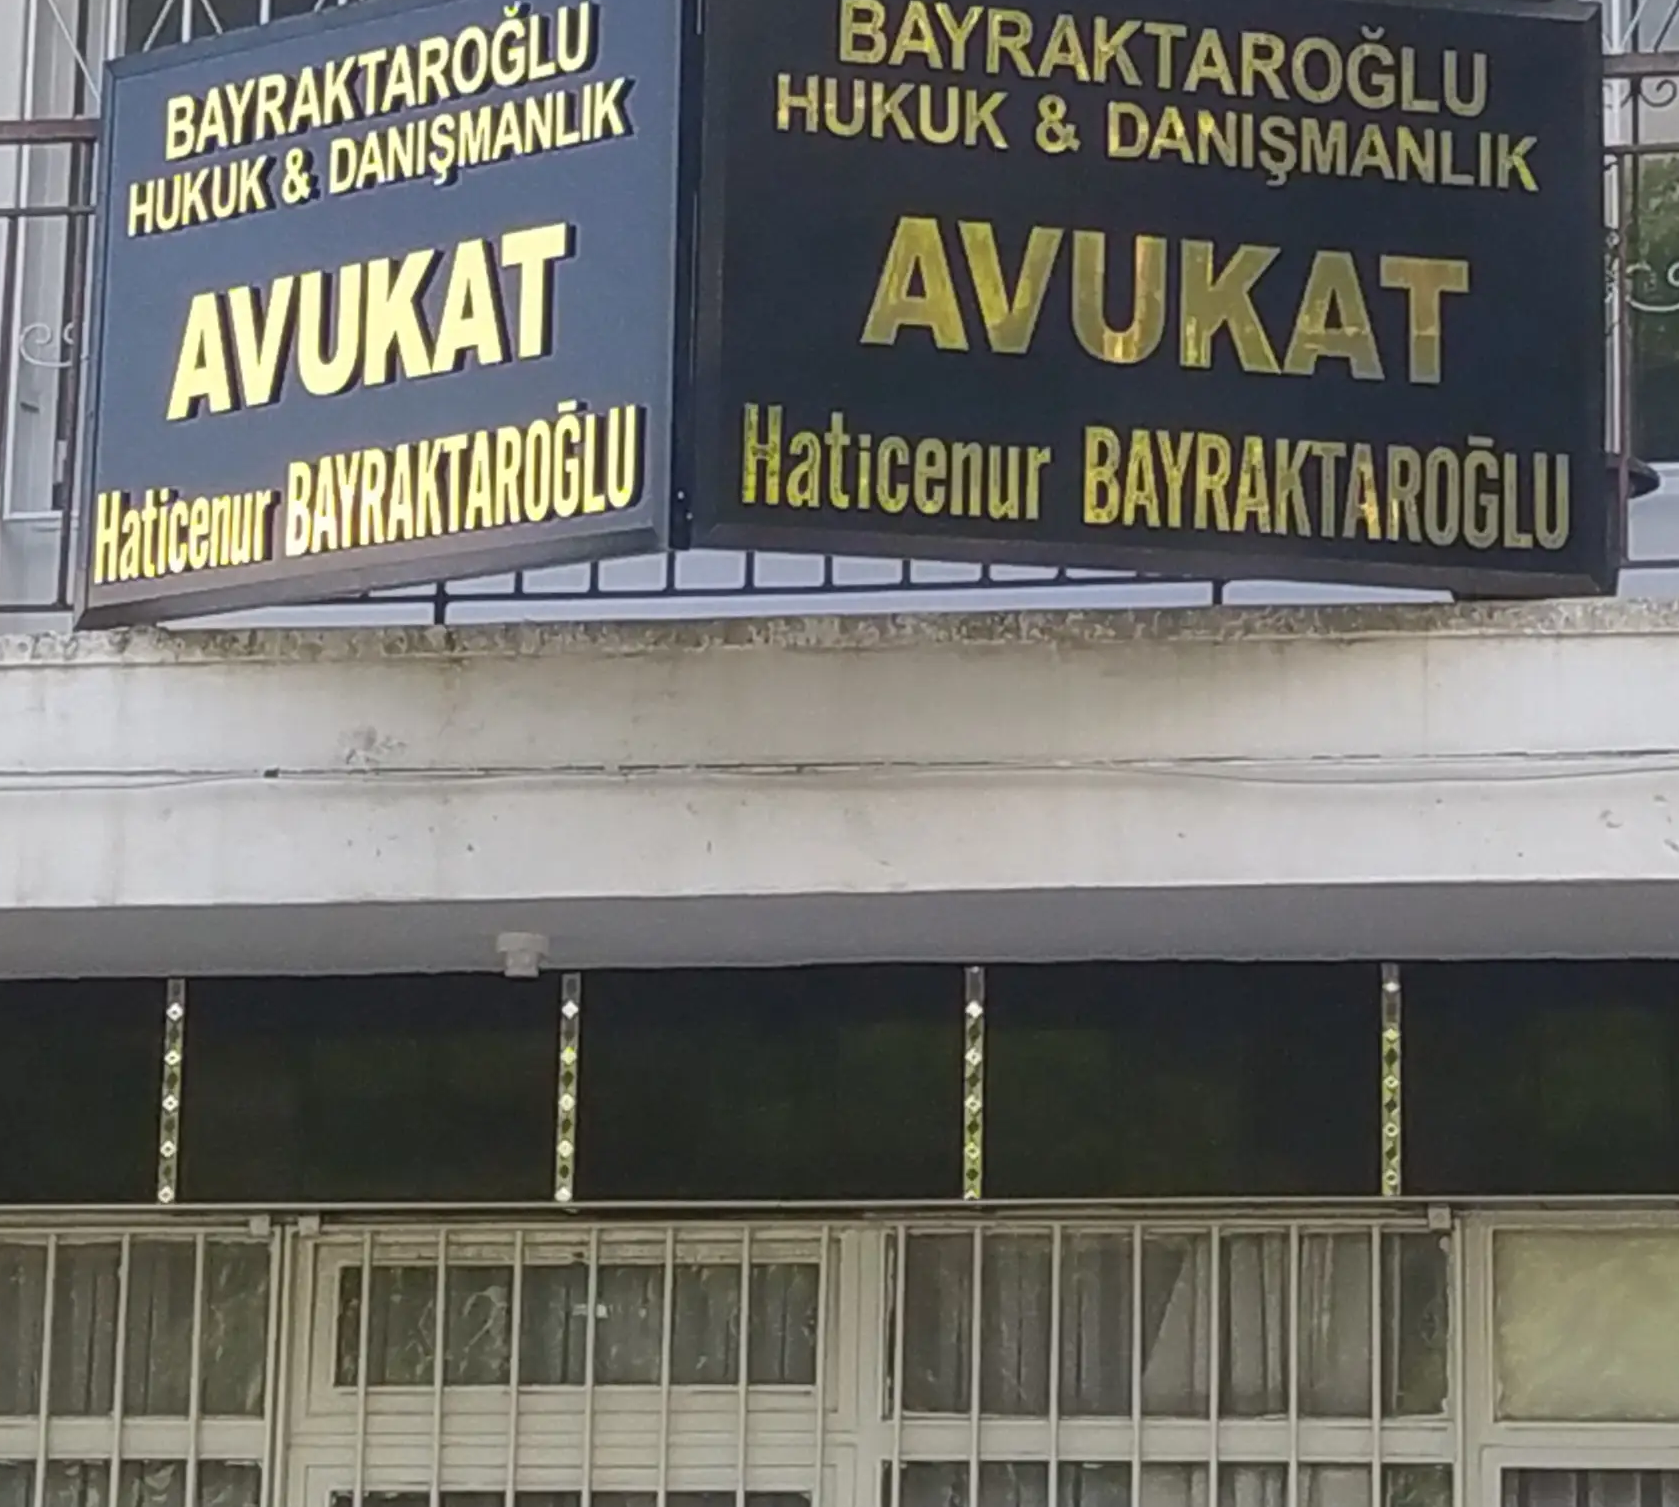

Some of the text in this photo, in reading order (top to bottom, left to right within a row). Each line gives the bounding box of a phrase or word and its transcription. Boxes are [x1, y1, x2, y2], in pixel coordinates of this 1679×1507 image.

[128, 77, 626, 236] HUKUK & DANIŞMANLIK
[165, 0, 592, 161] BAYRAKTAROĞLU
[775, 73, 1540, 193] HUKUK & DANIŞMANLIK
[166, 222, 569, 421] AVUKAT
[859, 215, 1470, 384] AVUKAT
[94, 401, 638, 584] Haticenur BAYRAKTAROĞLU
[741, 403, 1571, 551] Haticenur BAYRAKTAROĞLU
